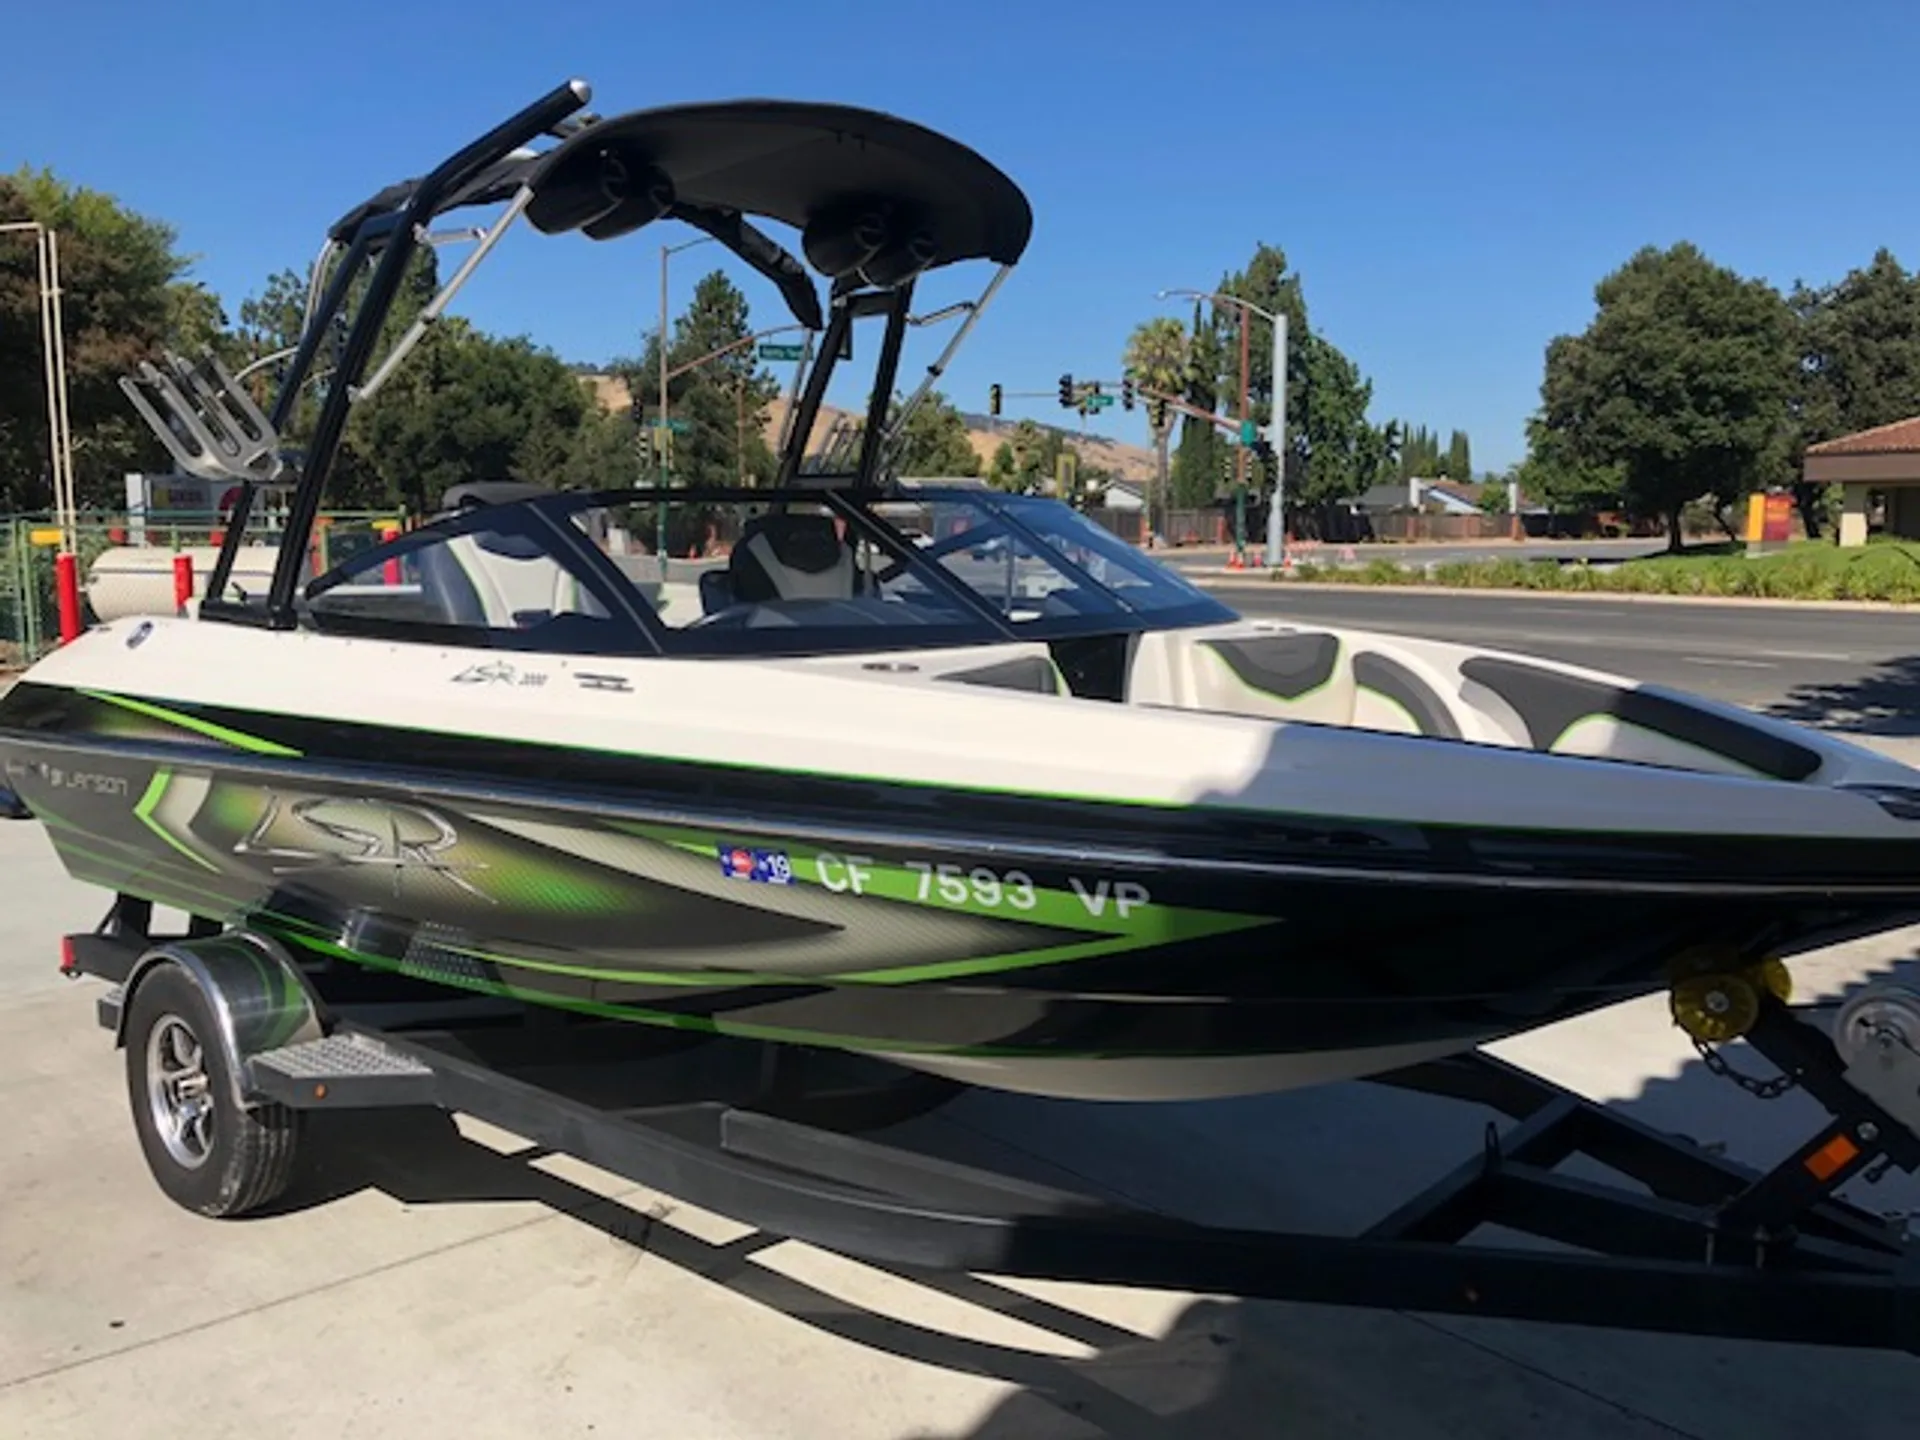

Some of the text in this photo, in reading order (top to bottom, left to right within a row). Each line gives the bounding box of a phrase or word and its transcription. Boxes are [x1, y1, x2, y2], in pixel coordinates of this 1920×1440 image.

[233, 786, 498, 904] LSR
[766, 854, 791, 878] 19
[816, 852, 1151, 919] CF 7593 VP
